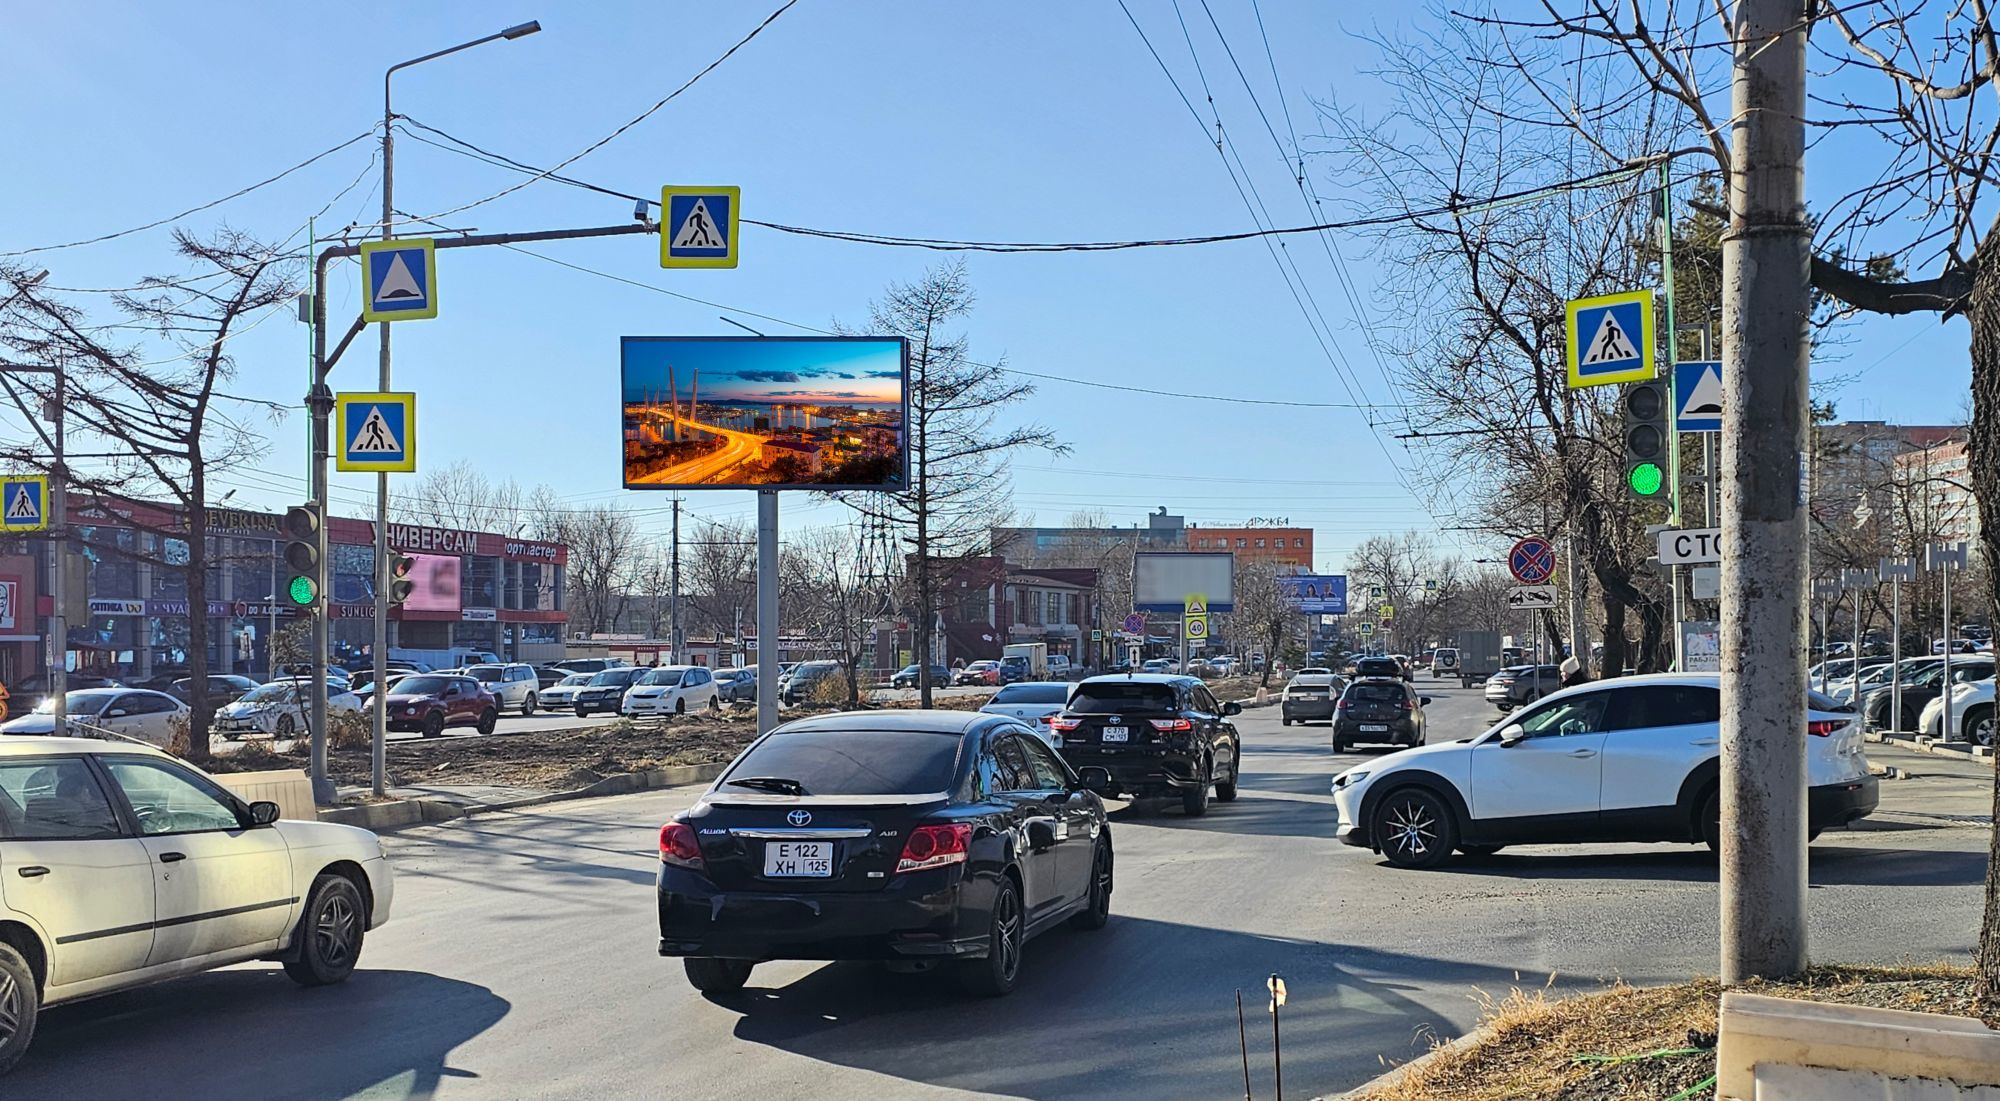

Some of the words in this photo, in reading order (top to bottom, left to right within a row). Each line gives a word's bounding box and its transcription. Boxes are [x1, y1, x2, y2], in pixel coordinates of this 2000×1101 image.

[341, 605, 376, 618] SUNLIG
[1191, 624, 1202, 632] 40
[780, 844, 790, 858] Е
[794, 844, 819, 858] 122
[775, 860, 796, 875] ХН
[808, 860, 828, 872] 125
